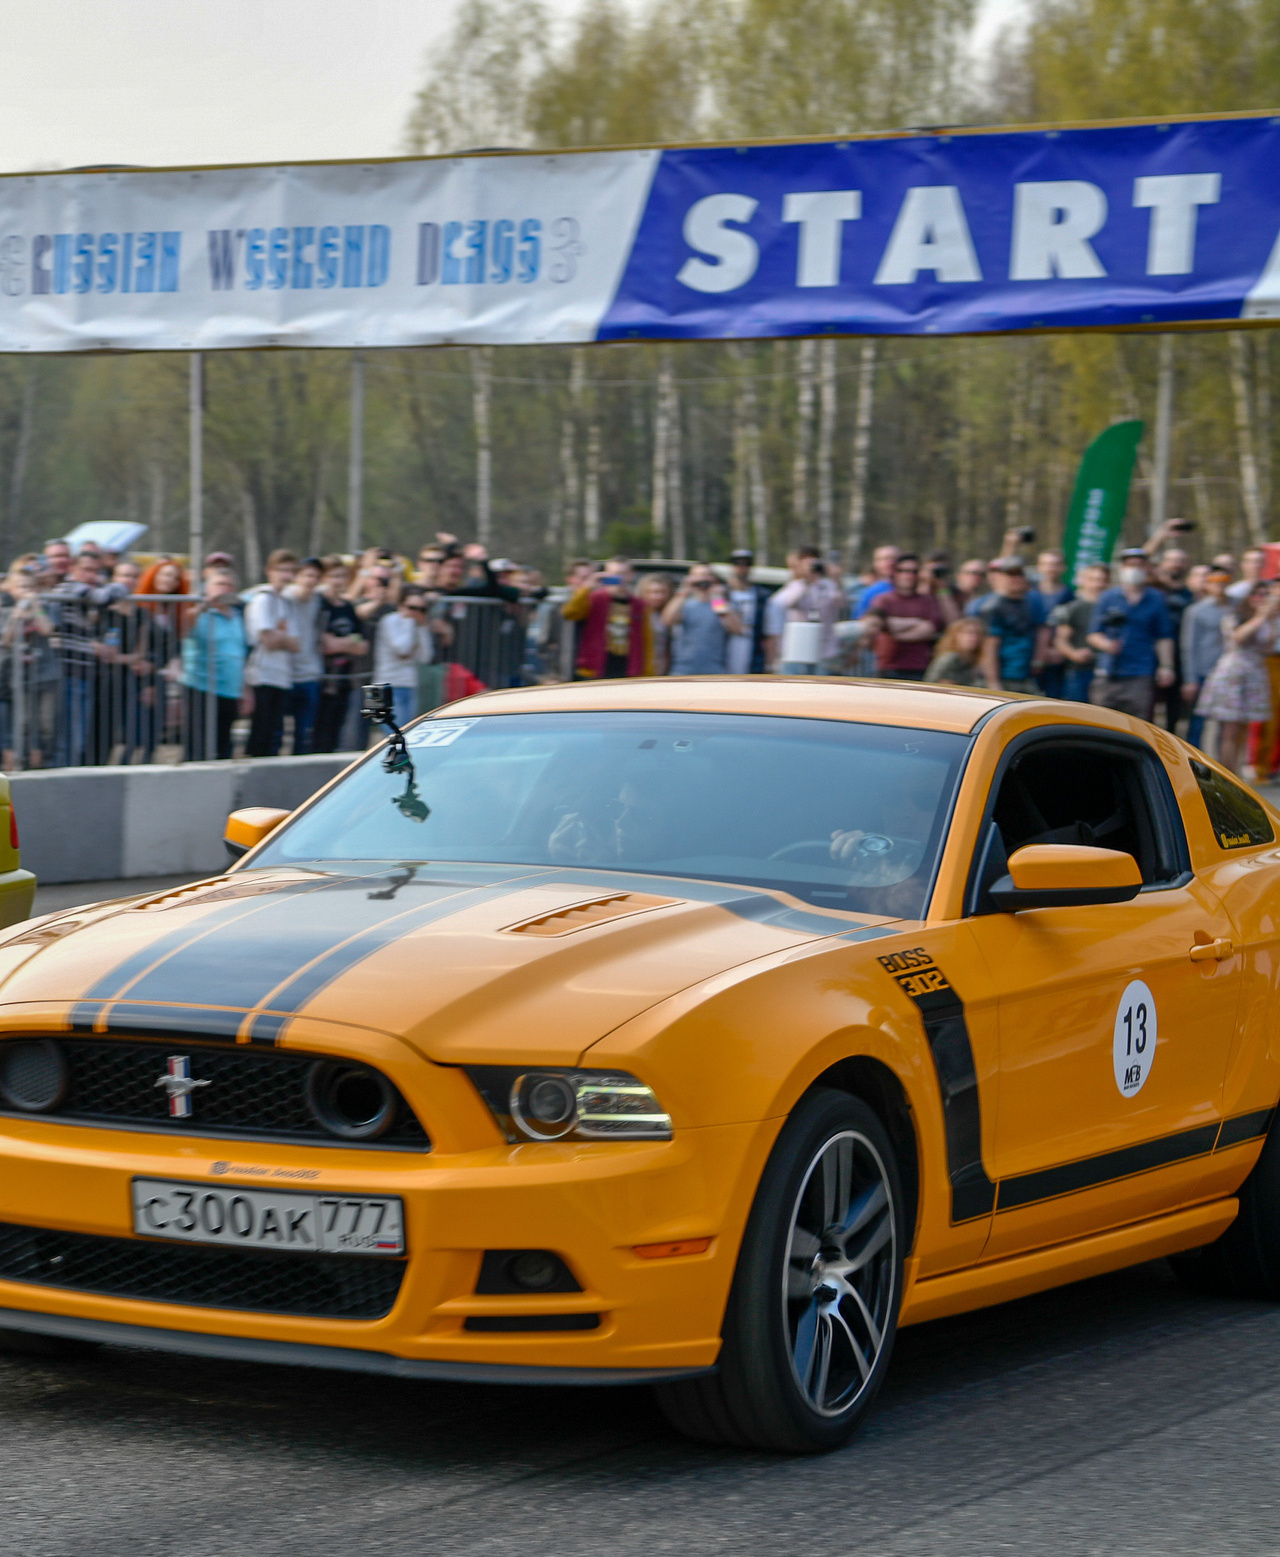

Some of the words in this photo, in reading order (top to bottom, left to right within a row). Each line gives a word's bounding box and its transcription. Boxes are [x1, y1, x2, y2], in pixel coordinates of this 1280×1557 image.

[207, 224, 390, 291] WEEKEND
[415, 218, 543, 286] DRAGS
[675, 173, 1221, 293] START
[876, 947, 934, 973] BOSS
[899, 970, 950, 998] 302
[1122, 1002, 1148, 1056] 13
[318, 1199, 388, 1234] 777
